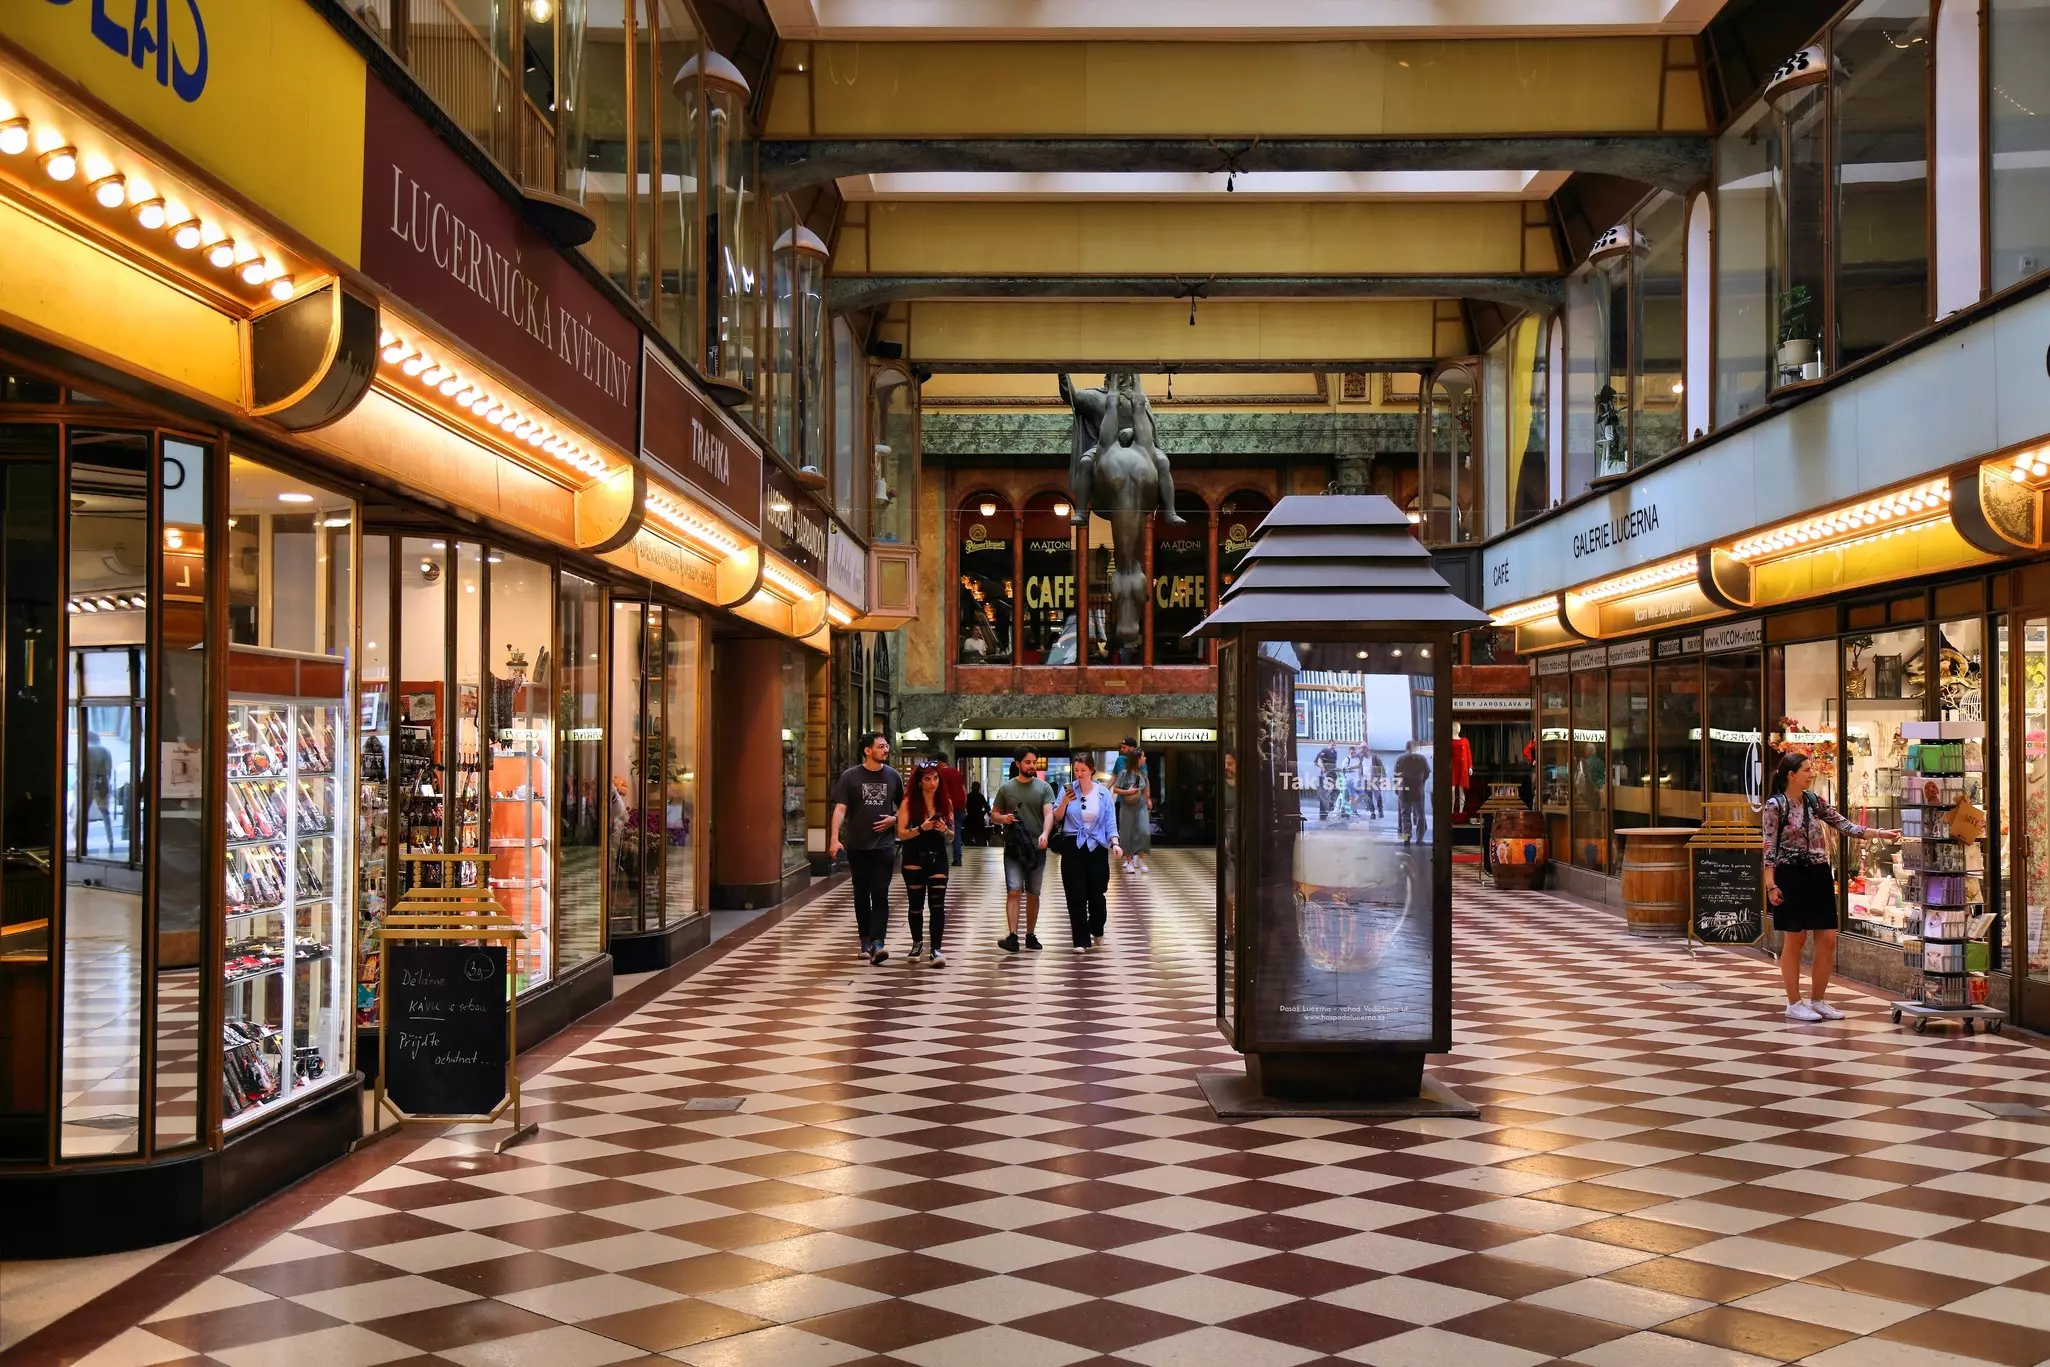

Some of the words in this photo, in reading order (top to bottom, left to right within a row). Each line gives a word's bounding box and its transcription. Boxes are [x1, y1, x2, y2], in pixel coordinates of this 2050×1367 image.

[390, 163, 553, 350] LUCERNIČKA
[558, 306, 632, 408] KVĚTINY
[691, 416, 730, 487] TRAFIKA
[767, 484, 794, 539] LUCERNA
[1573, 522, 1610, 559] GALERIE
[1611, 503, 1660, 545] LUCERNA
[1030, 541, 1070, 549] MATTONI
[1160, 541, 1201, 549] MATTONI
[1492, 558, 1509, 587] CAFÉ
[1026, 575, 1075, 609] CAFE
[1156, 575, 1205, 609] CAFE
[1314, 712, 1375, 722] HOSPOD
[1279, 772, 1317, 790] Tak
[1323, 776, 1347, 790] se
[1357, 772, 1410, 791] ukaž.
[401, 968, 446, 986] Děláme
[448, 1003, 455, 1011] s
[459, 998, 487, 1012] sebou
[1279, 1004, 1300, 1012] Pasáž
[1363, 1004, 1399, 1012] Vodičkova
